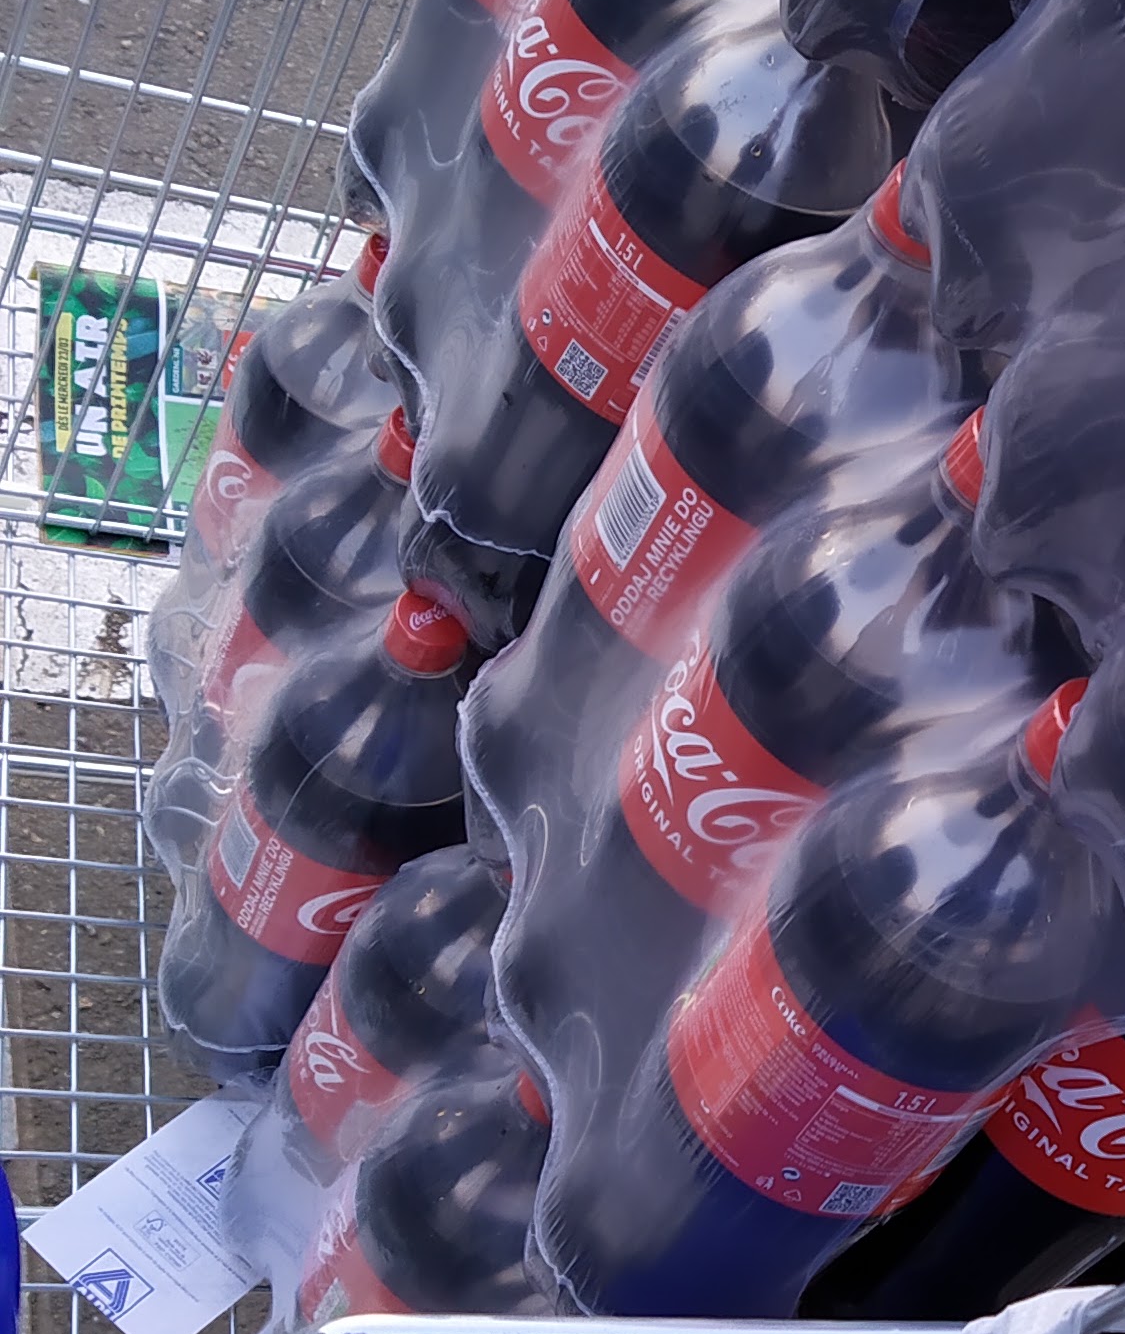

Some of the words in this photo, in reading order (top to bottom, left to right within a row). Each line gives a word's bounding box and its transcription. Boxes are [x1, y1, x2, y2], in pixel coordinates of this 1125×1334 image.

[74, 314, 108, 397] AIR
[111, 318, 128, 431] PRINTEMPS
[58, 404, 69, 415] LE
[74, 404, 108, 456] UN
[111, 433, 128, 459] DE
[610, 564, 652, 626] ODDAJ
[645, 515, 682, 568] MNIE
[674, 487, 698, 521] DO
[646, 500, 714, 604] RECYKLINGU
[633, 734, 693, 864] ORIGINAL
[236, 886, 260, 928] ODDAJ
[252, 855, 274, 890] MNIE
[266, 837, 280, 859] DO
[259, 848, 294, 915] RECYKLINGU
[771, 985, 806, 1037] Coke
[1005, 1101, 1089, 1180] IGINAL
